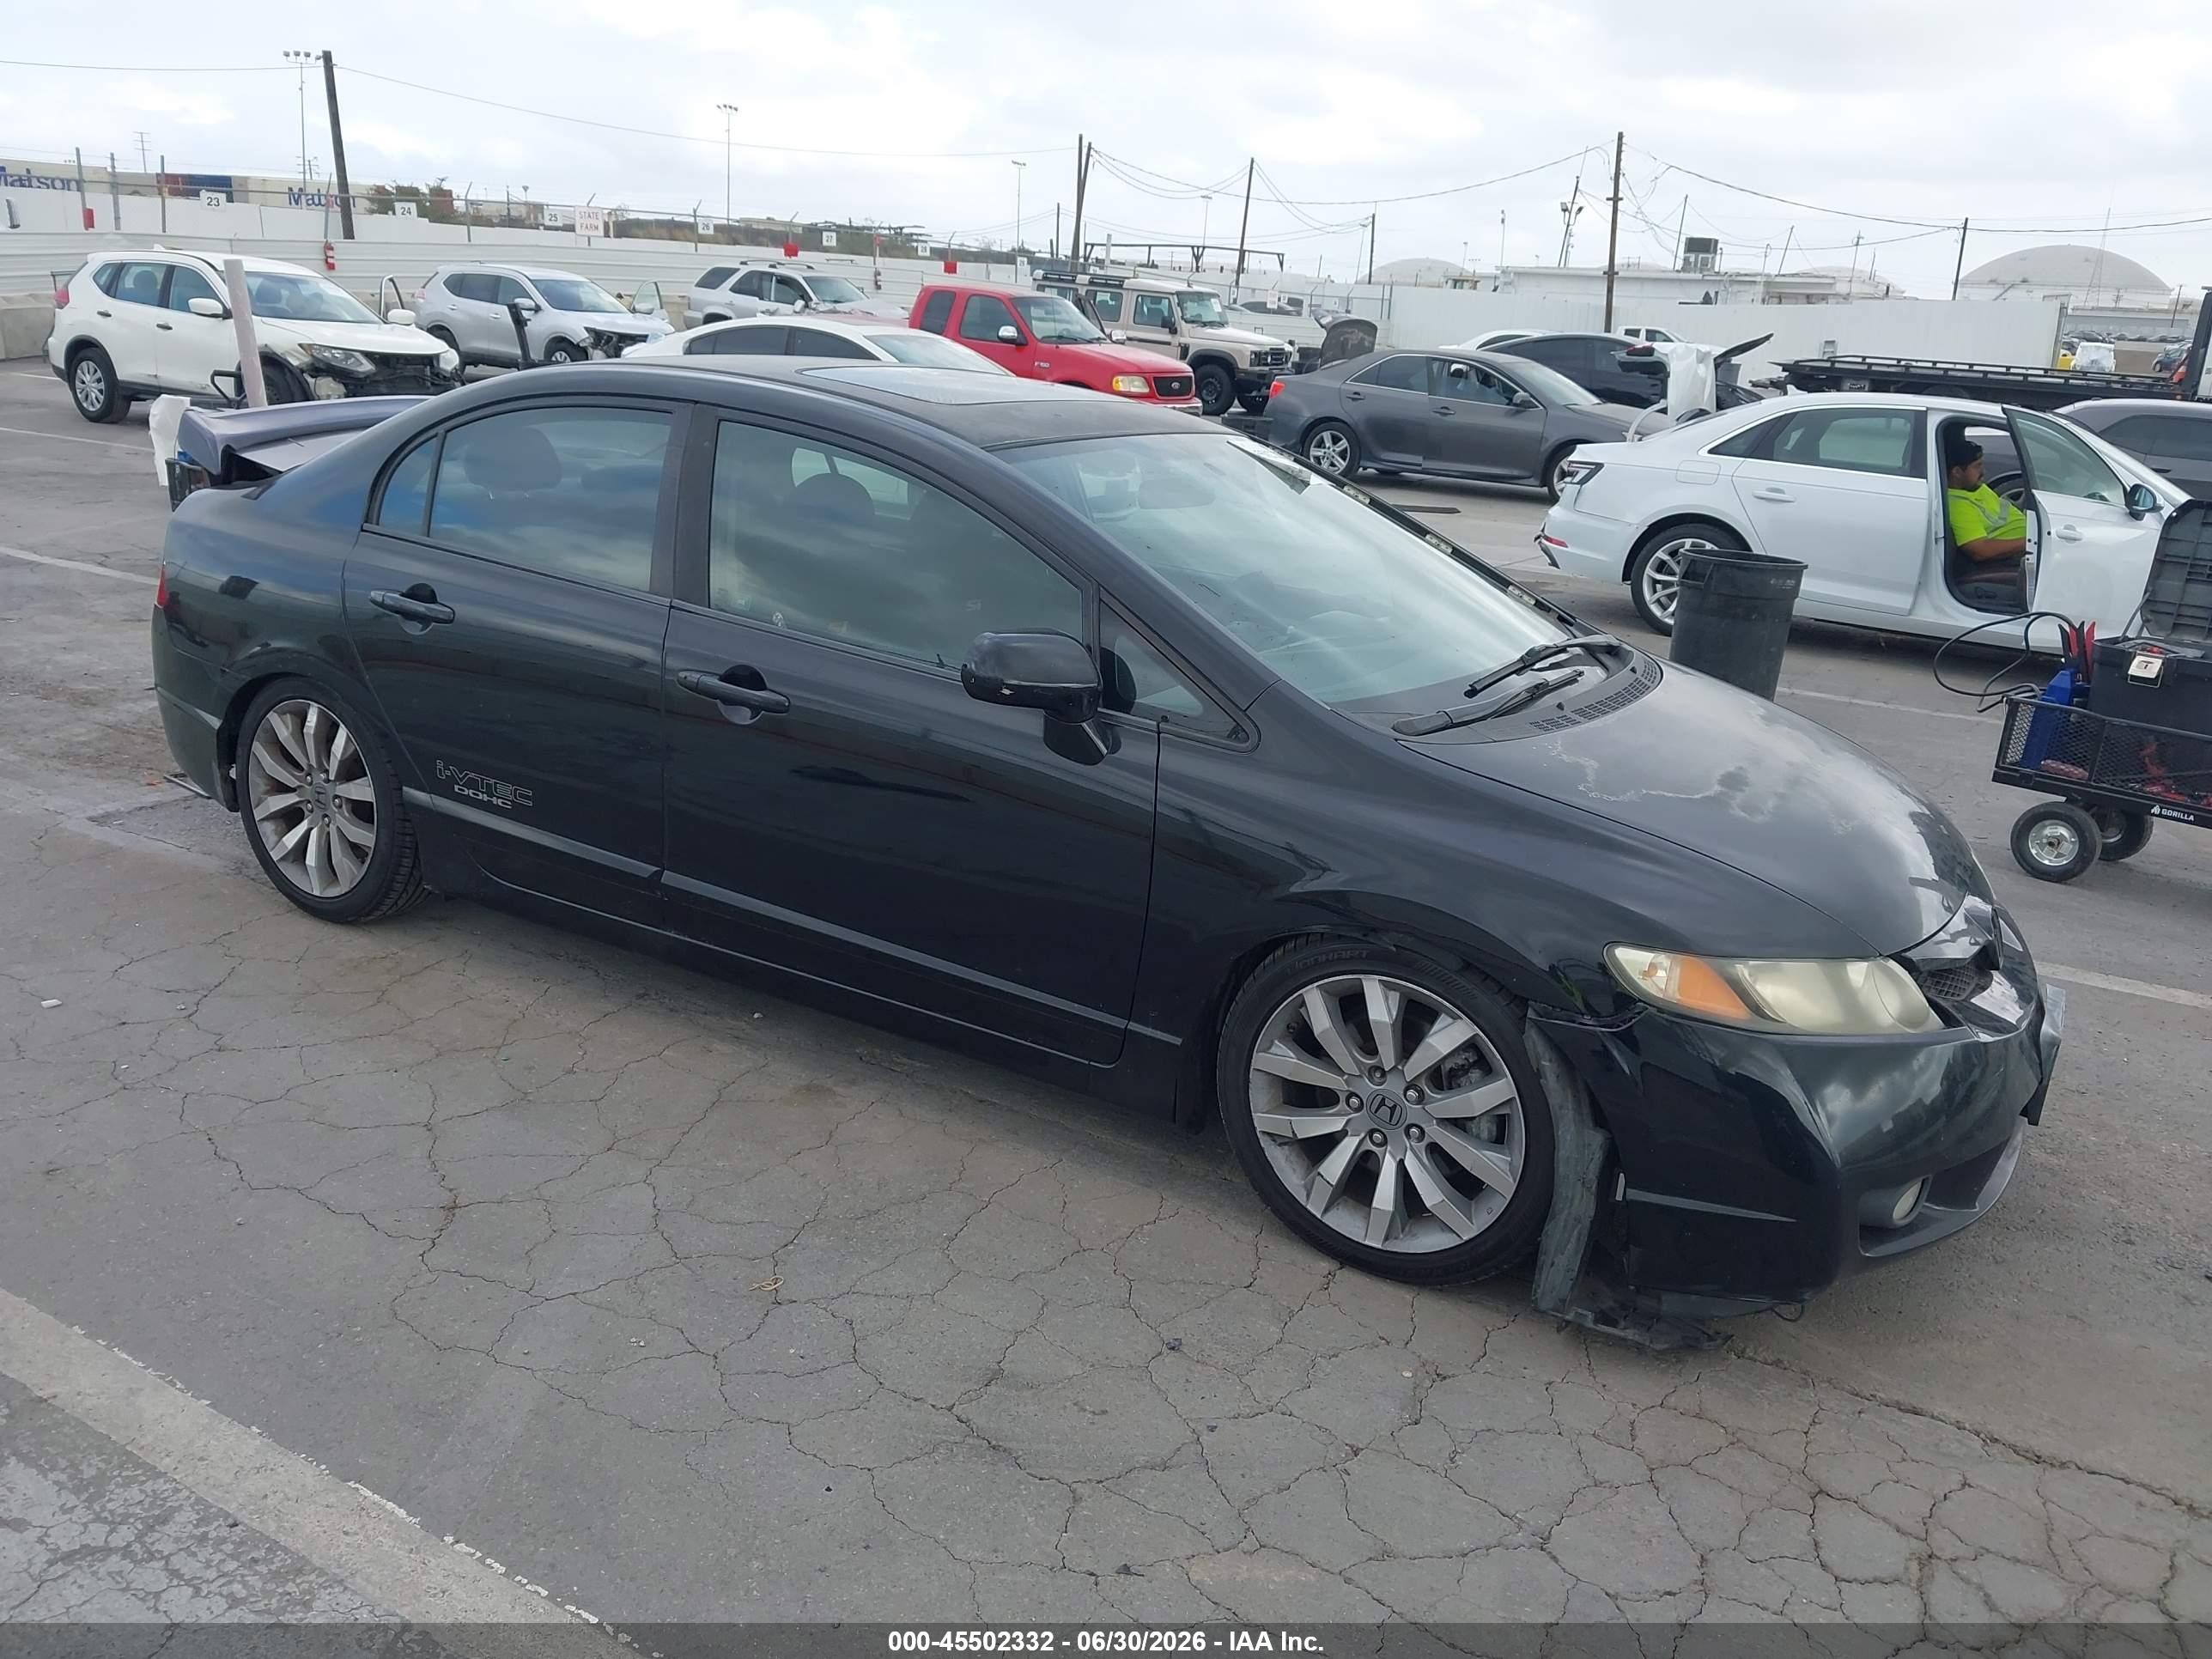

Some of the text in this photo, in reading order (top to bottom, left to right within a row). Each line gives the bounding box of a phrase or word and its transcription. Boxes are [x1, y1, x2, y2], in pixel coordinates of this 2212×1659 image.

[206, 197, 220, 207] 23
[400, 206, 411, 216] 24
[579, 211, 599, 221] STATE
[549, 213, 558, 222] 25
[825, 234, 834, 243] 27
[436, 759, 533, 807] i-VTEC
[453, 784, 513, 809] DOHC
[2161, 808, 2195, 822] GORILLA
